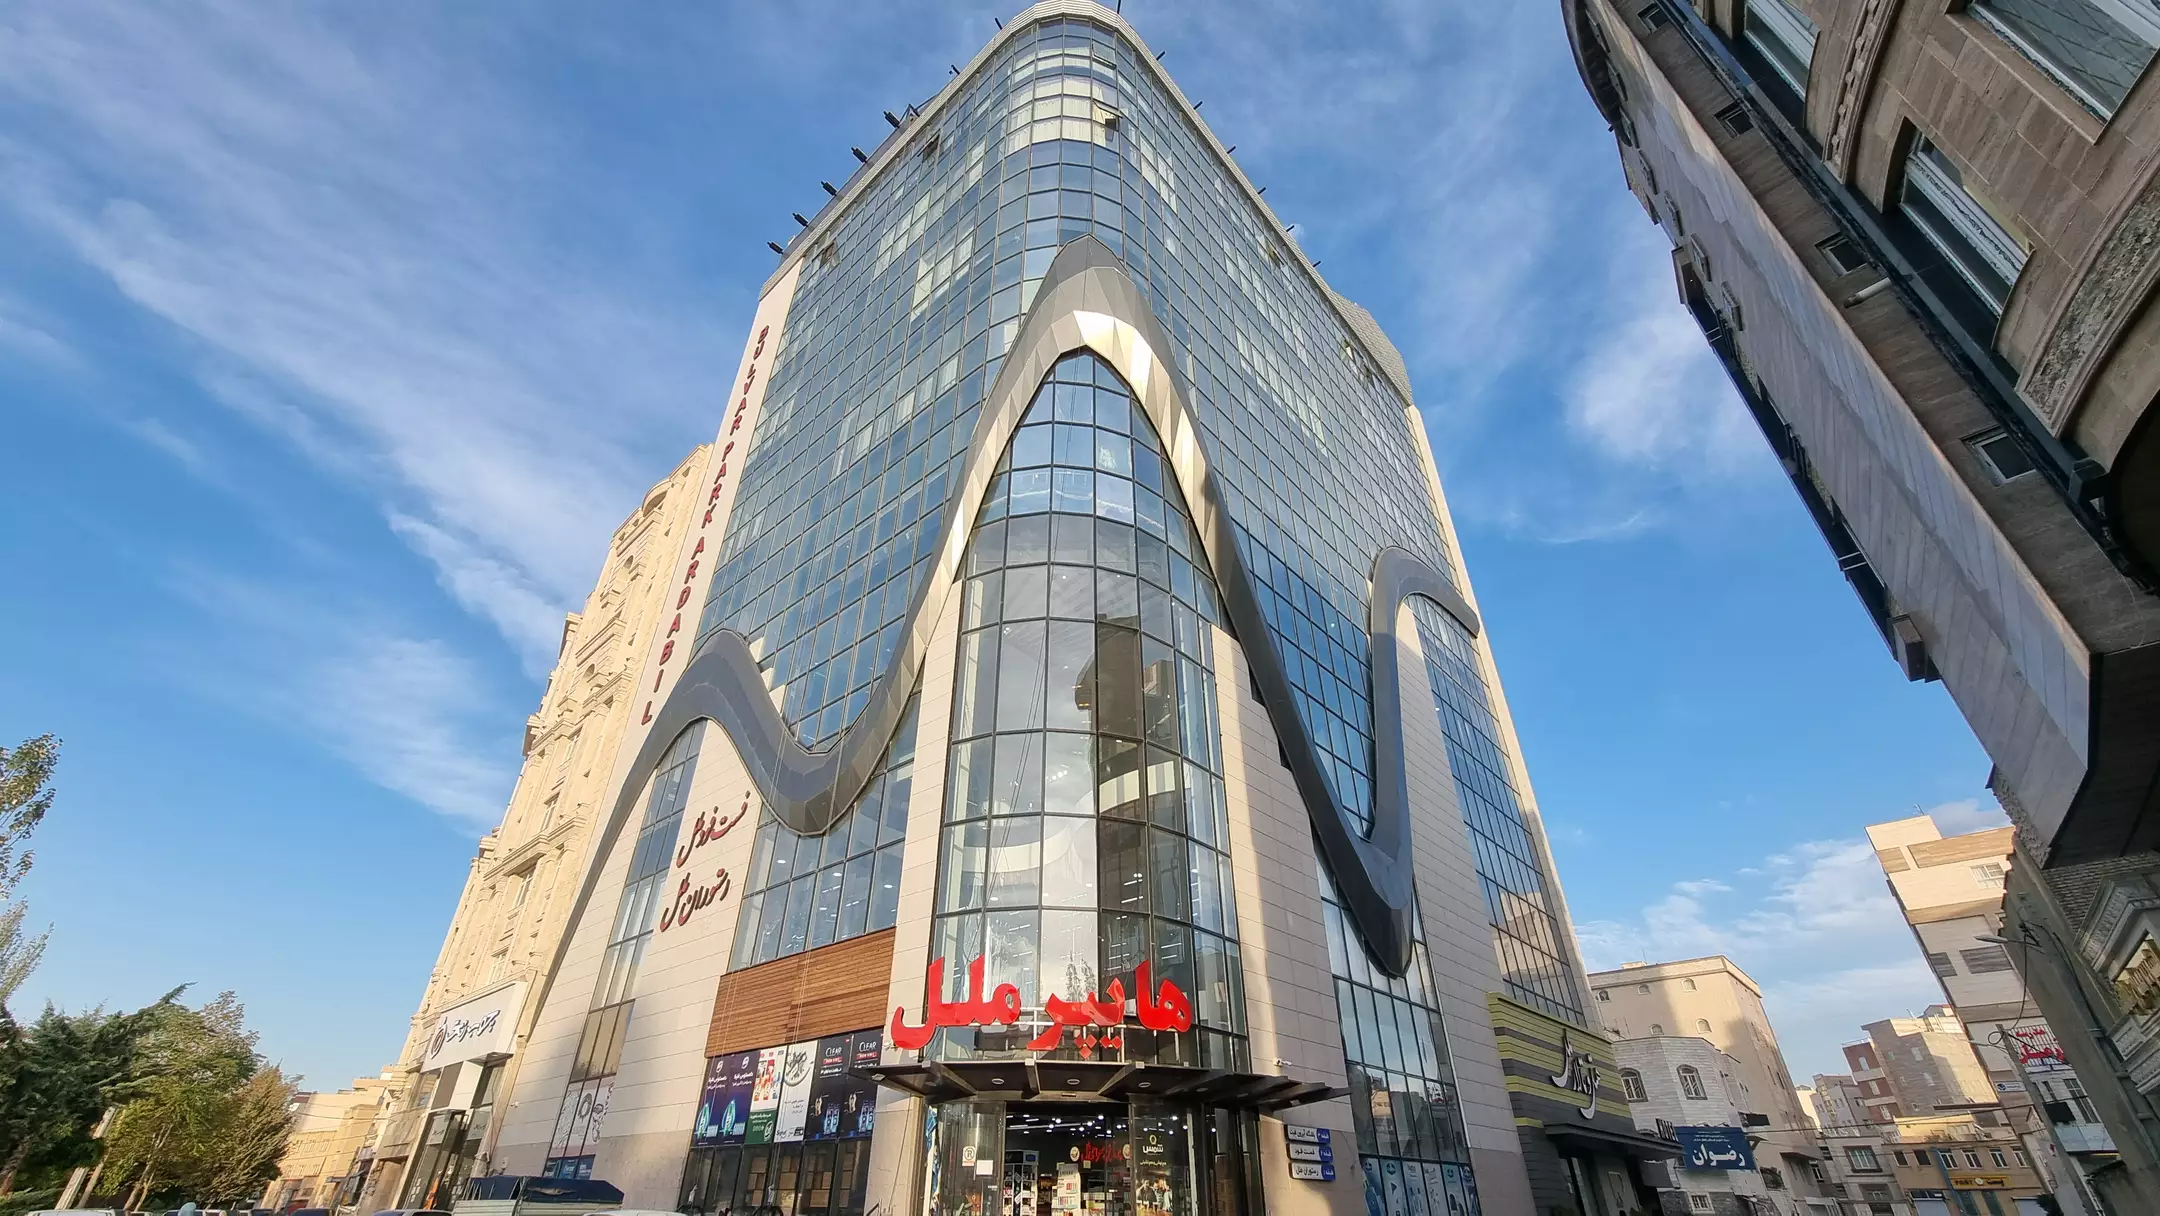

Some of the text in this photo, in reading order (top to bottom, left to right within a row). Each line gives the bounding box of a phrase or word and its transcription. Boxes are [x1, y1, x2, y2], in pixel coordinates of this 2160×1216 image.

[641, 325, 769, 726] BULVAR PARK ARDABIL
[678, 868, 731, 927] رستوران
[890, 953, 1192, 1060] هایپر ملل
[825, 1046, 843, 1057] CLEAR
[858, 1041, 877, 1052] CLEAR
[1692, 1143, 1746, 1167] رضوان
